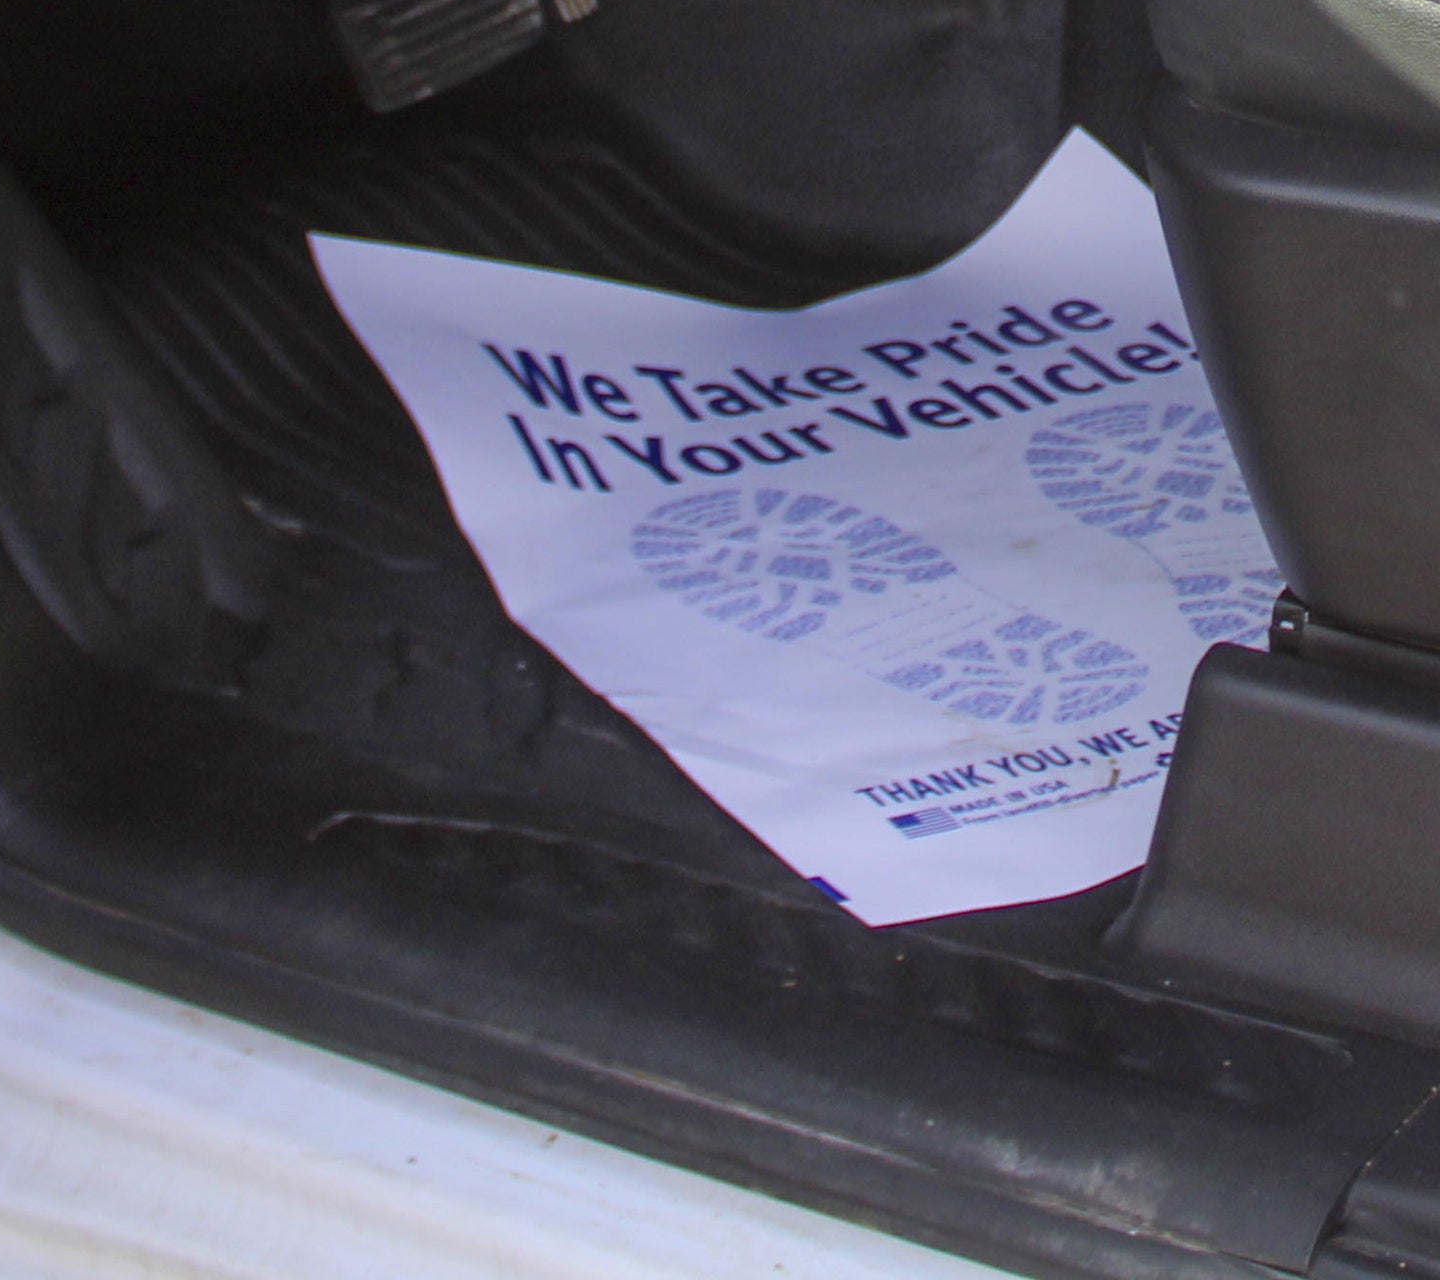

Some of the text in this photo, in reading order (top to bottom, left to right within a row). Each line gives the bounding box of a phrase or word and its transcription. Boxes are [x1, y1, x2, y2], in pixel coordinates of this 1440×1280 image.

[480, 299, 1114, 423] We Take Pride
[505, 321, 1200, 493] In Your Vehicle!
[854, 763, 996, 807] THANK
[984, 745, 1092, 777] YOU,
[1077, 727, 1150, 757] WE
[947, 780, 1069, 814] MADE IN USA
